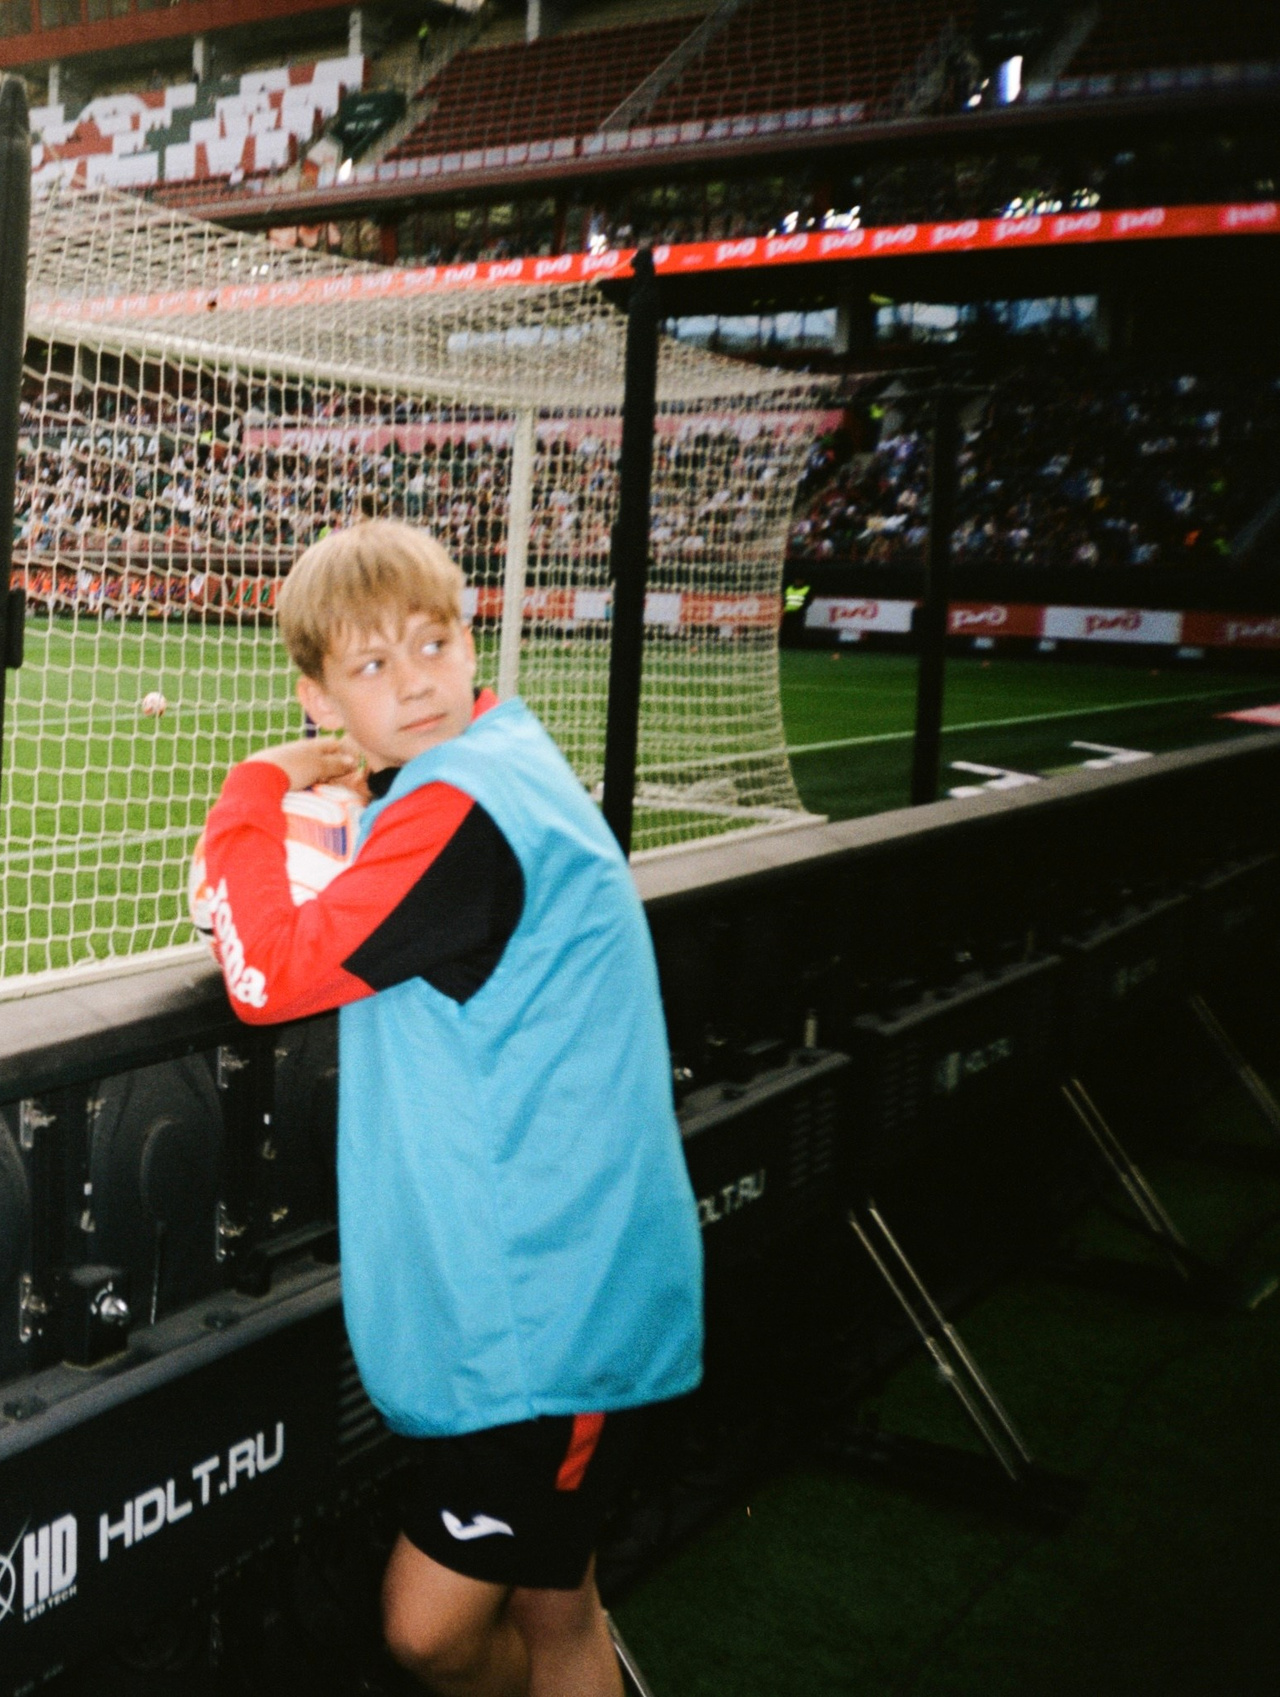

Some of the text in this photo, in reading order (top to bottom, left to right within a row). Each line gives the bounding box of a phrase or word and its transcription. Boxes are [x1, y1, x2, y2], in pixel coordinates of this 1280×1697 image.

[699, 1169, 766, 1227] DLT.RU
[99, 1421, 284, 1562] HDLT.RU
[23, 1513, 77, 1609] HD
